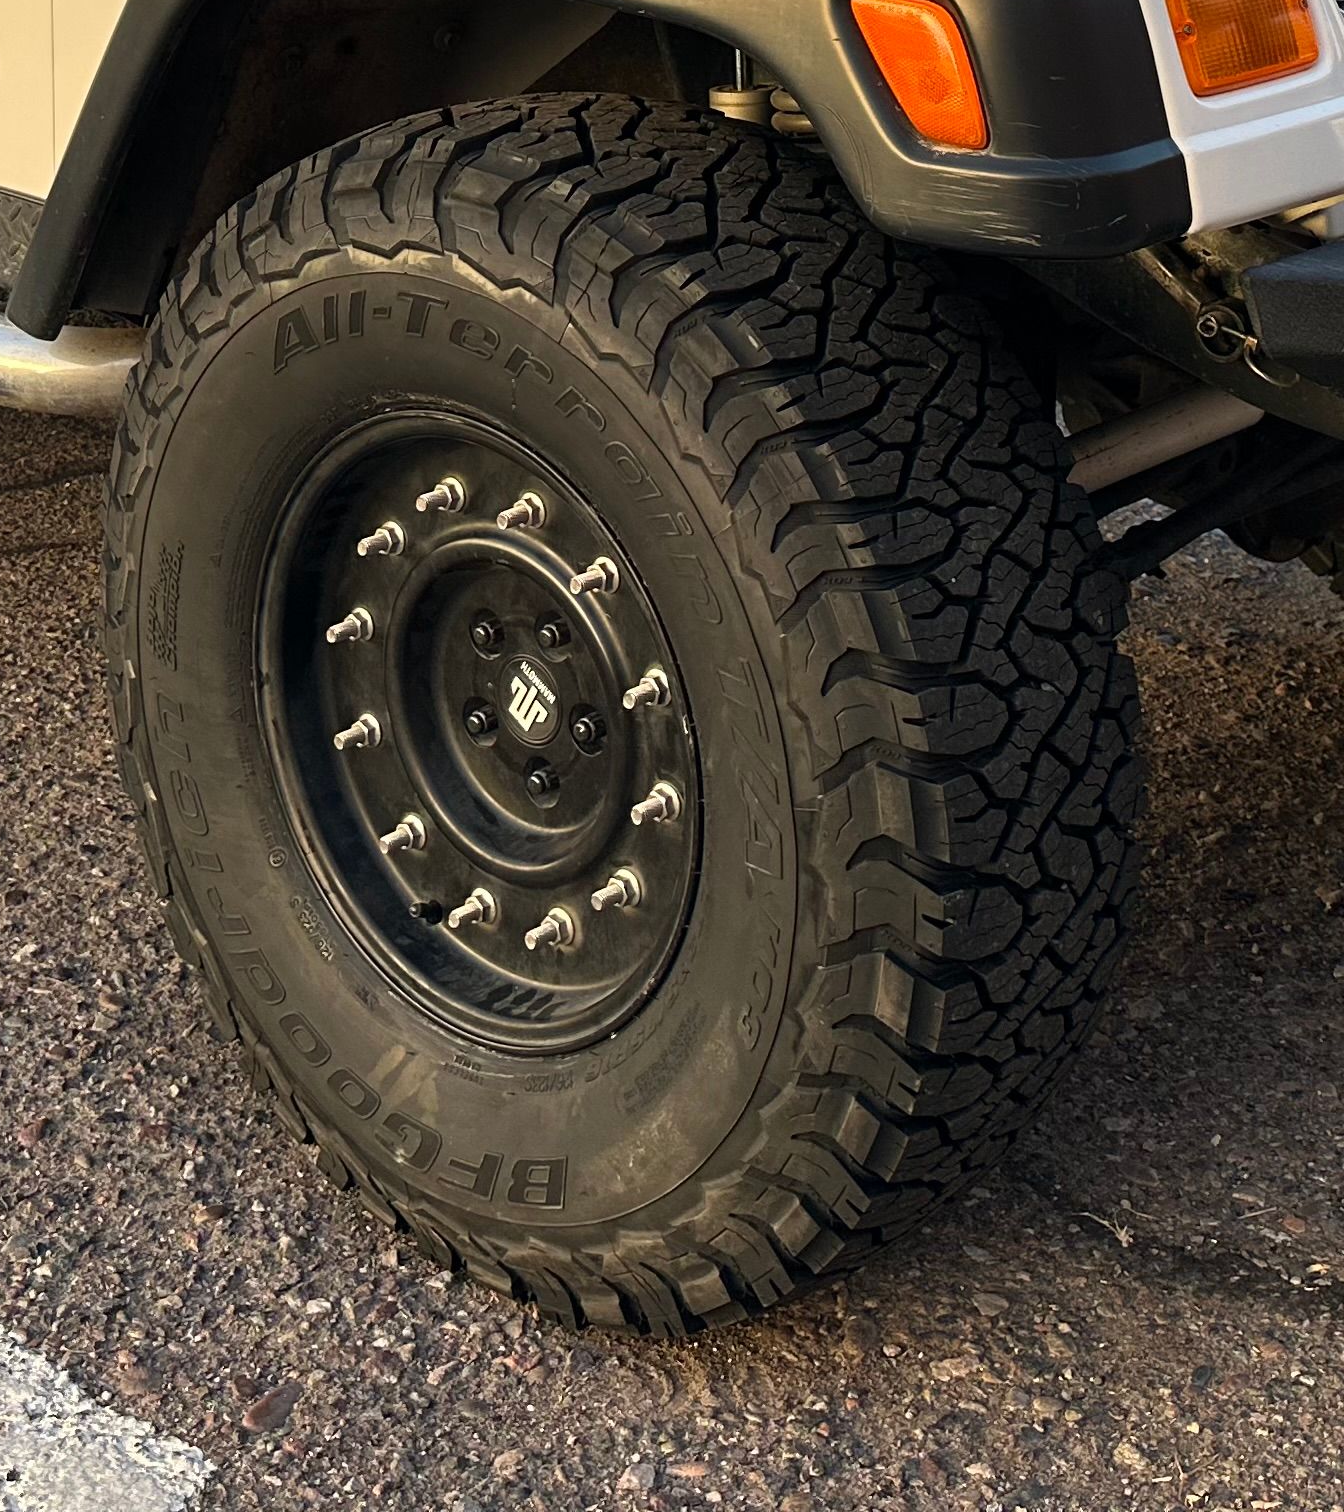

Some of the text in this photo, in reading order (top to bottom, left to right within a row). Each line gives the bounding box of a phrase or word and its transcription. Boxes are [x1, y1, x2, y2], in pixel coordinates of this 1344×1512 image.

[272, 290, 723, 625] All-Terrain
[520, 660, 557, 705] MAMMOTH
[155, 690, 568, 1211] BFGoodrich
